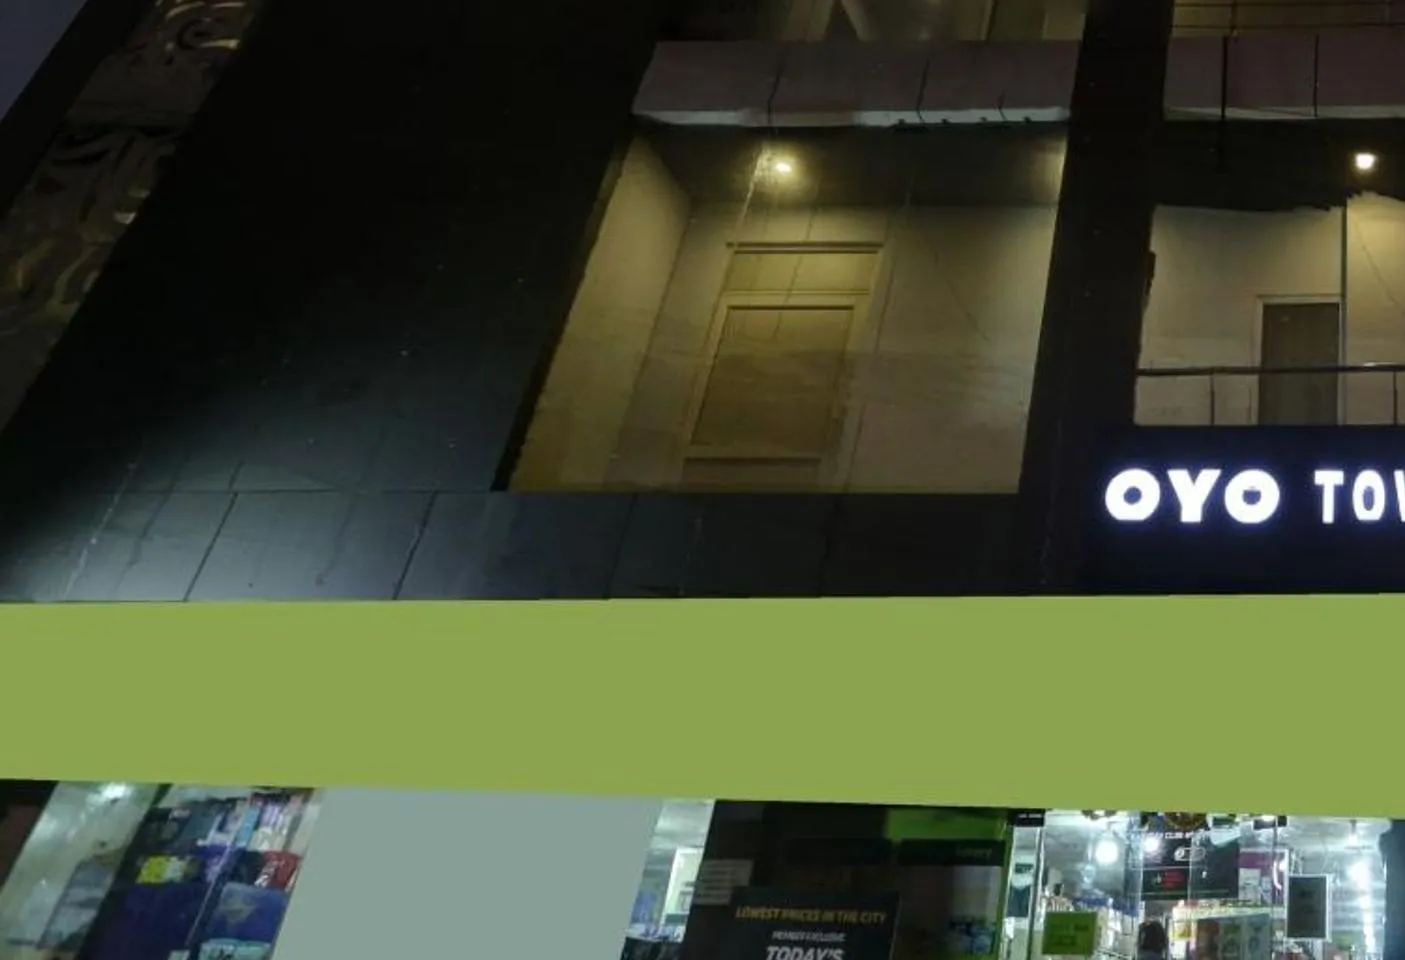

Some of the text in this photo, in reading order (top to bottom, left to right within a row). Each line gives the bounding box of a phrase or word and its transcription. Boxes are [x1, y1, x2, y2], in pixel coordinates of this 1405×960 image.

[1105, 469, 1280, 523] OYO
[735, 906, 888, 926] LOWEST PRICES IN THE CITY
[766, 945, 845, 960] TODAY'S
